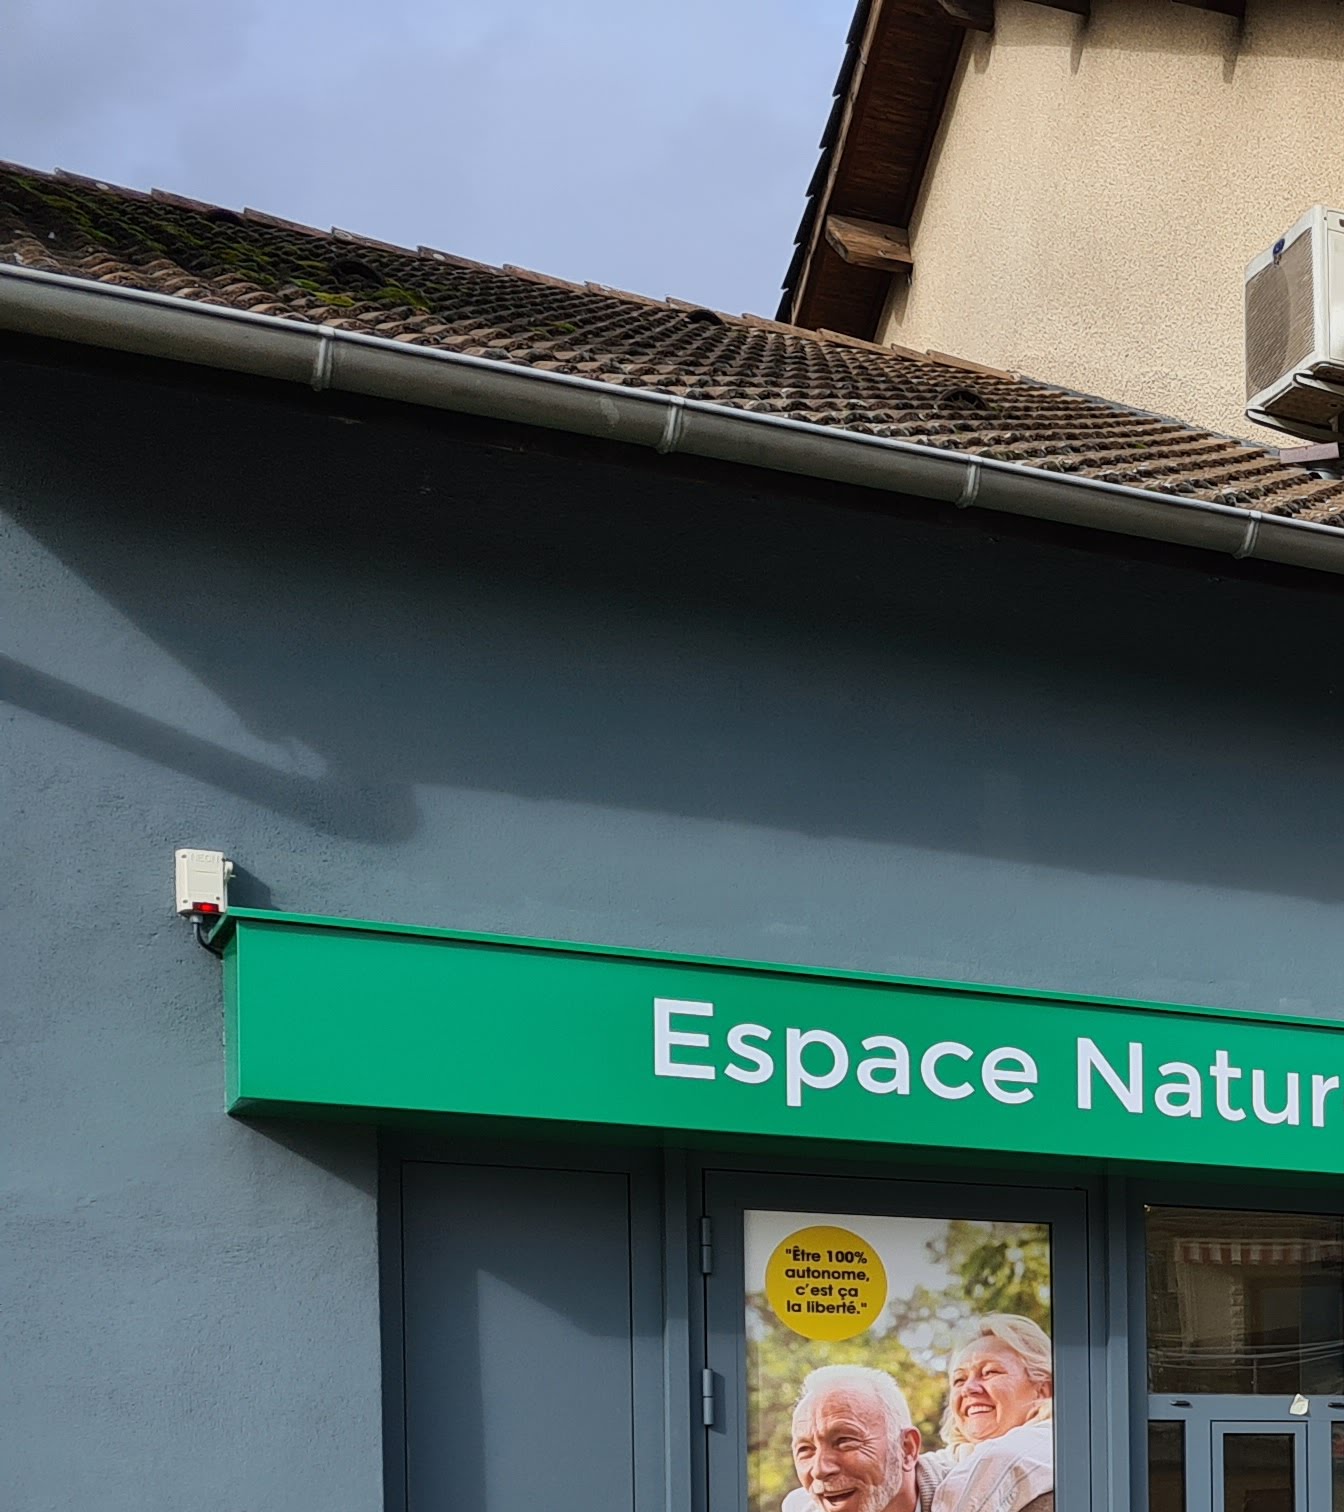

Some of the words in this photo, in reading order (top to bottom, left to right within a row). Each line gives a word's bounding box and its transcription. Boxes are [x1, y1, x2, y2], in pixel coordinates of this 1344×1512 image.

[653, 997, 1038, 1106] Espace
[785, 1245, 821, 1262] "Être
[827, 1250, 867, 1264] 100%
[785, 1267, 869, 1282] autonome,
[796, 1283, 833, 1296] c'est
[838, 1287, 858, 1300] ça
[787, 1300, 802, 1312] la
[807, 1301, 867, 1314] liberté."
